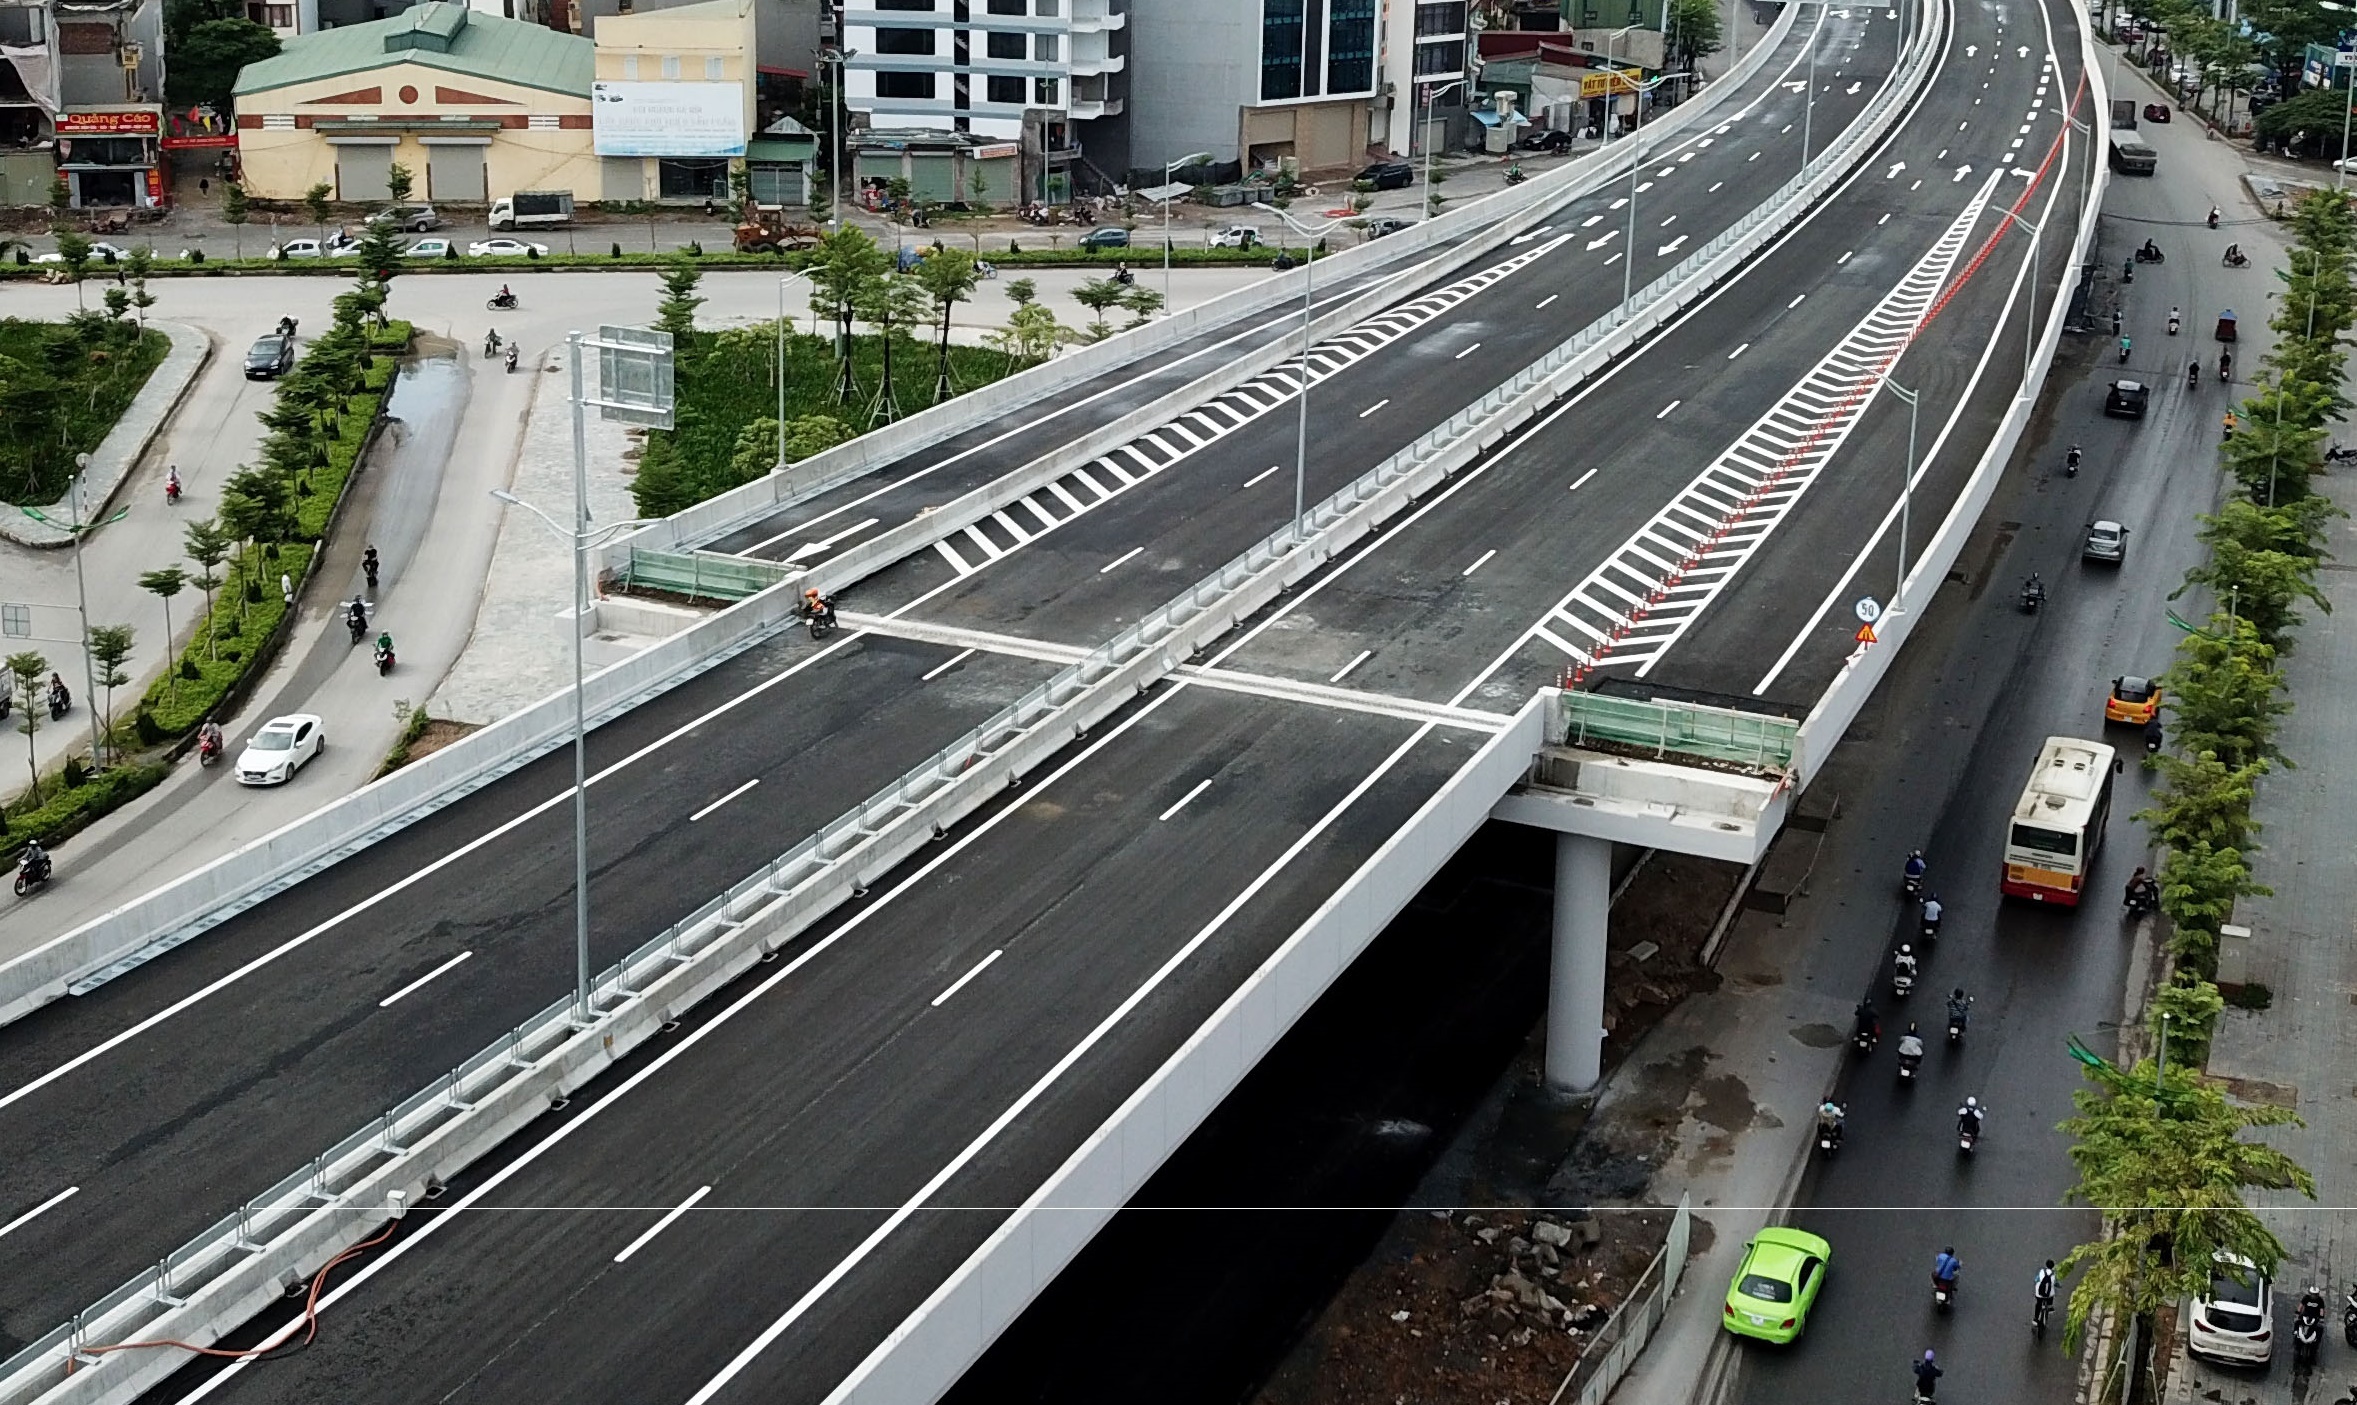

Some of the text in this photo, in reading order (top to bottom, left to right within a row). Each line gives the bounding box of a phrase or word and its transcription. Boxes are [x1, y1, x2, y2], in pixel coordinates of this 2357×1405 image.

[69, 113, 151, 126] Quảng Cáo
[1861, 602, 1874, 617] 50
